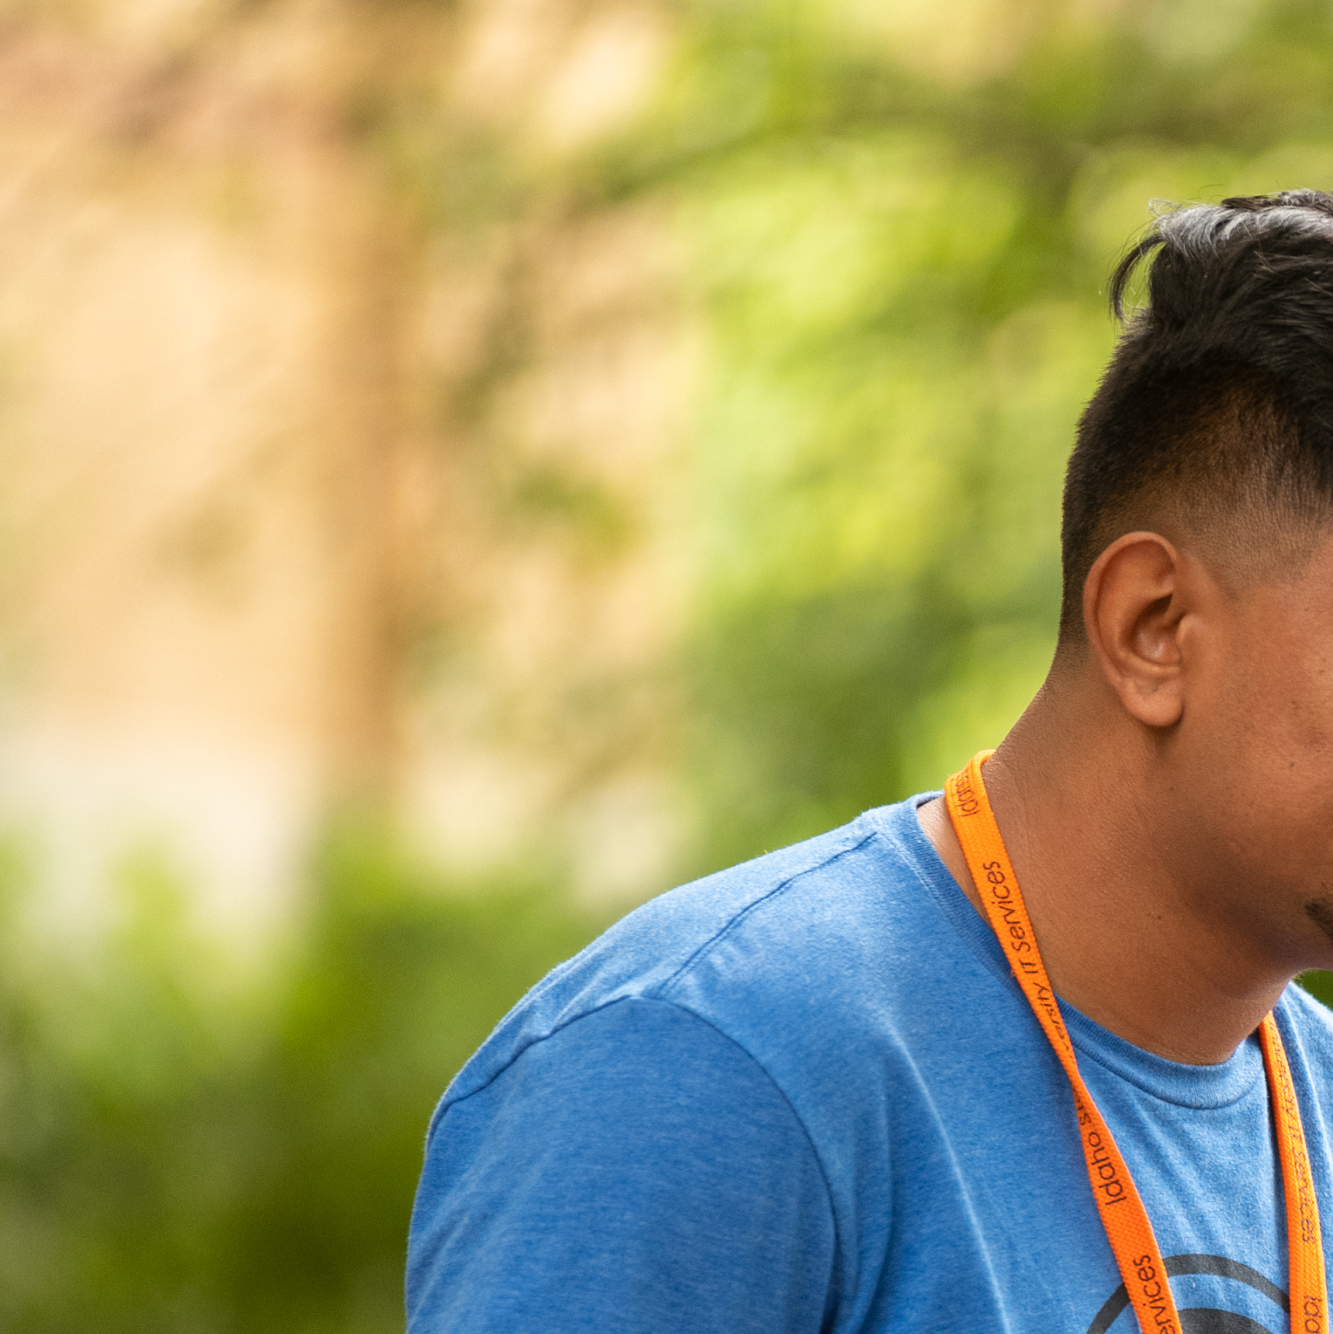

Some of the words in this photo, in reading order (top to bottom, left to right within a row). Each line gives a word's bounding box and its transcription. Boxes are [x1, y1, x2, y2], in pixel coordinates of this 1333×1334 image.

[983, 860, 1032, 953] Services
[1018, 961, 1039, 975] IT
[1088, 1131, 1127, 1206] Idaho
[1291, 1147, 1316, 1244] Services
